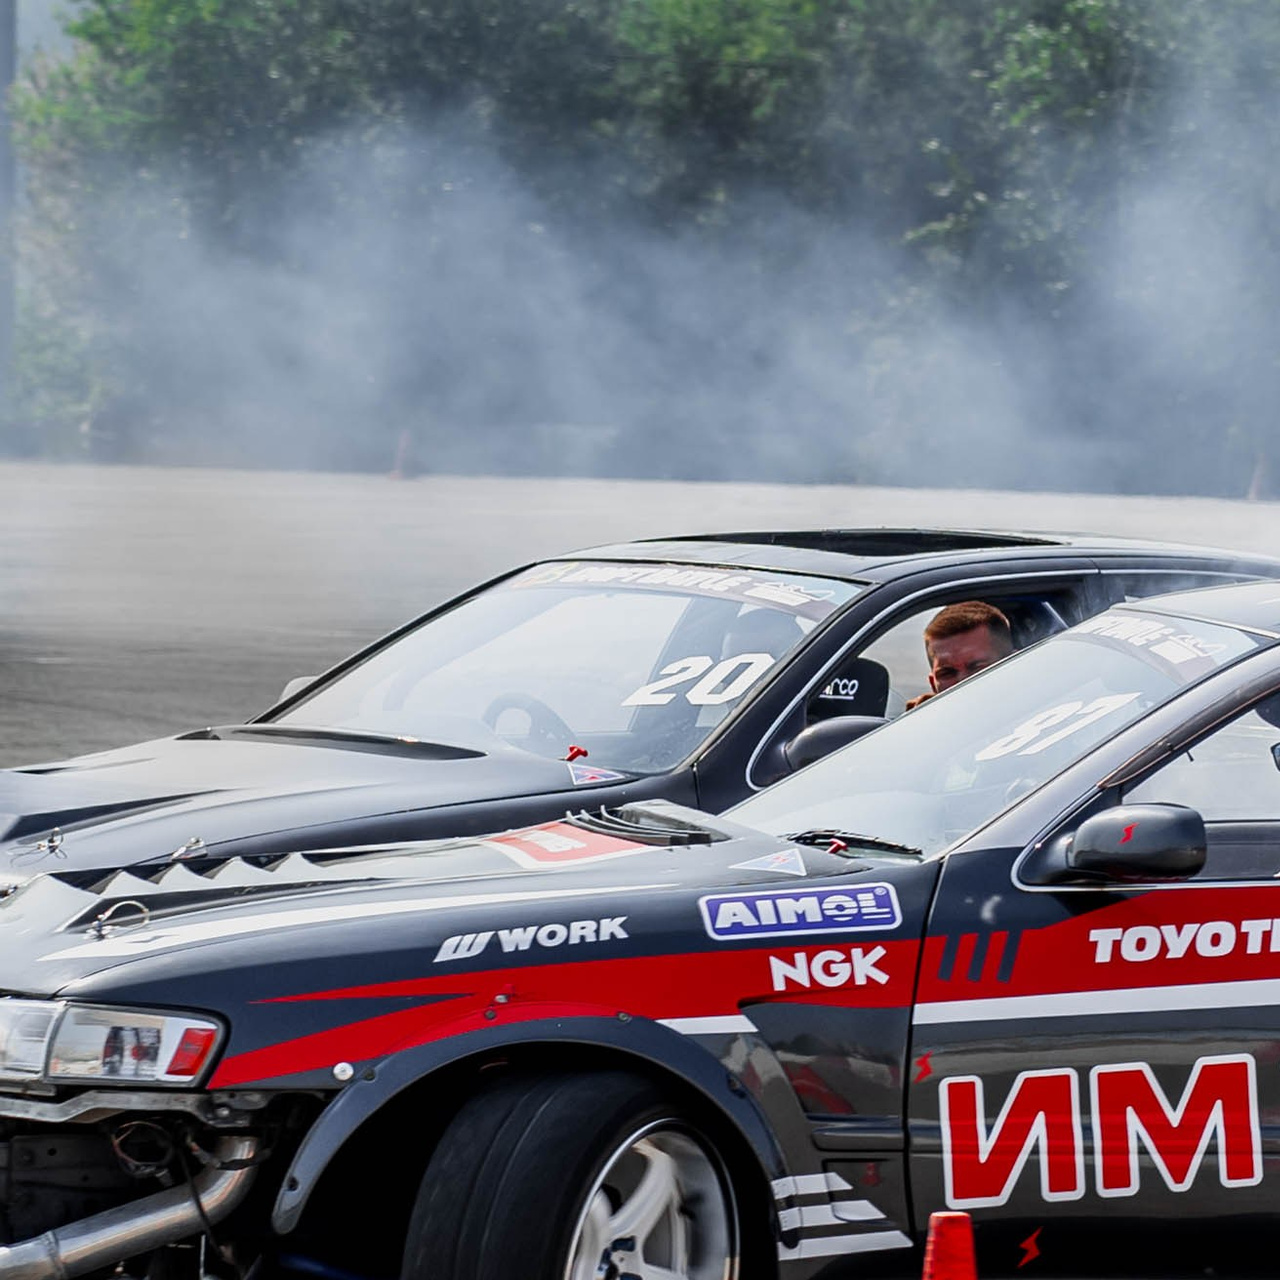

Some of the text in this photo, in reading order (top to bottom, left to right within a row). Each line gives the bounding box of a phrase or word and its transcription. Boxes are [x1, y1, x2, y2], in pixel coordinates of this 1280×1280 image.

[620, 653, 776, 706] 20
[498, 916, 629, 953] WORK
[1089, 922, 1237, 963] TOYO
[769, 945, 890, 991] NGK
